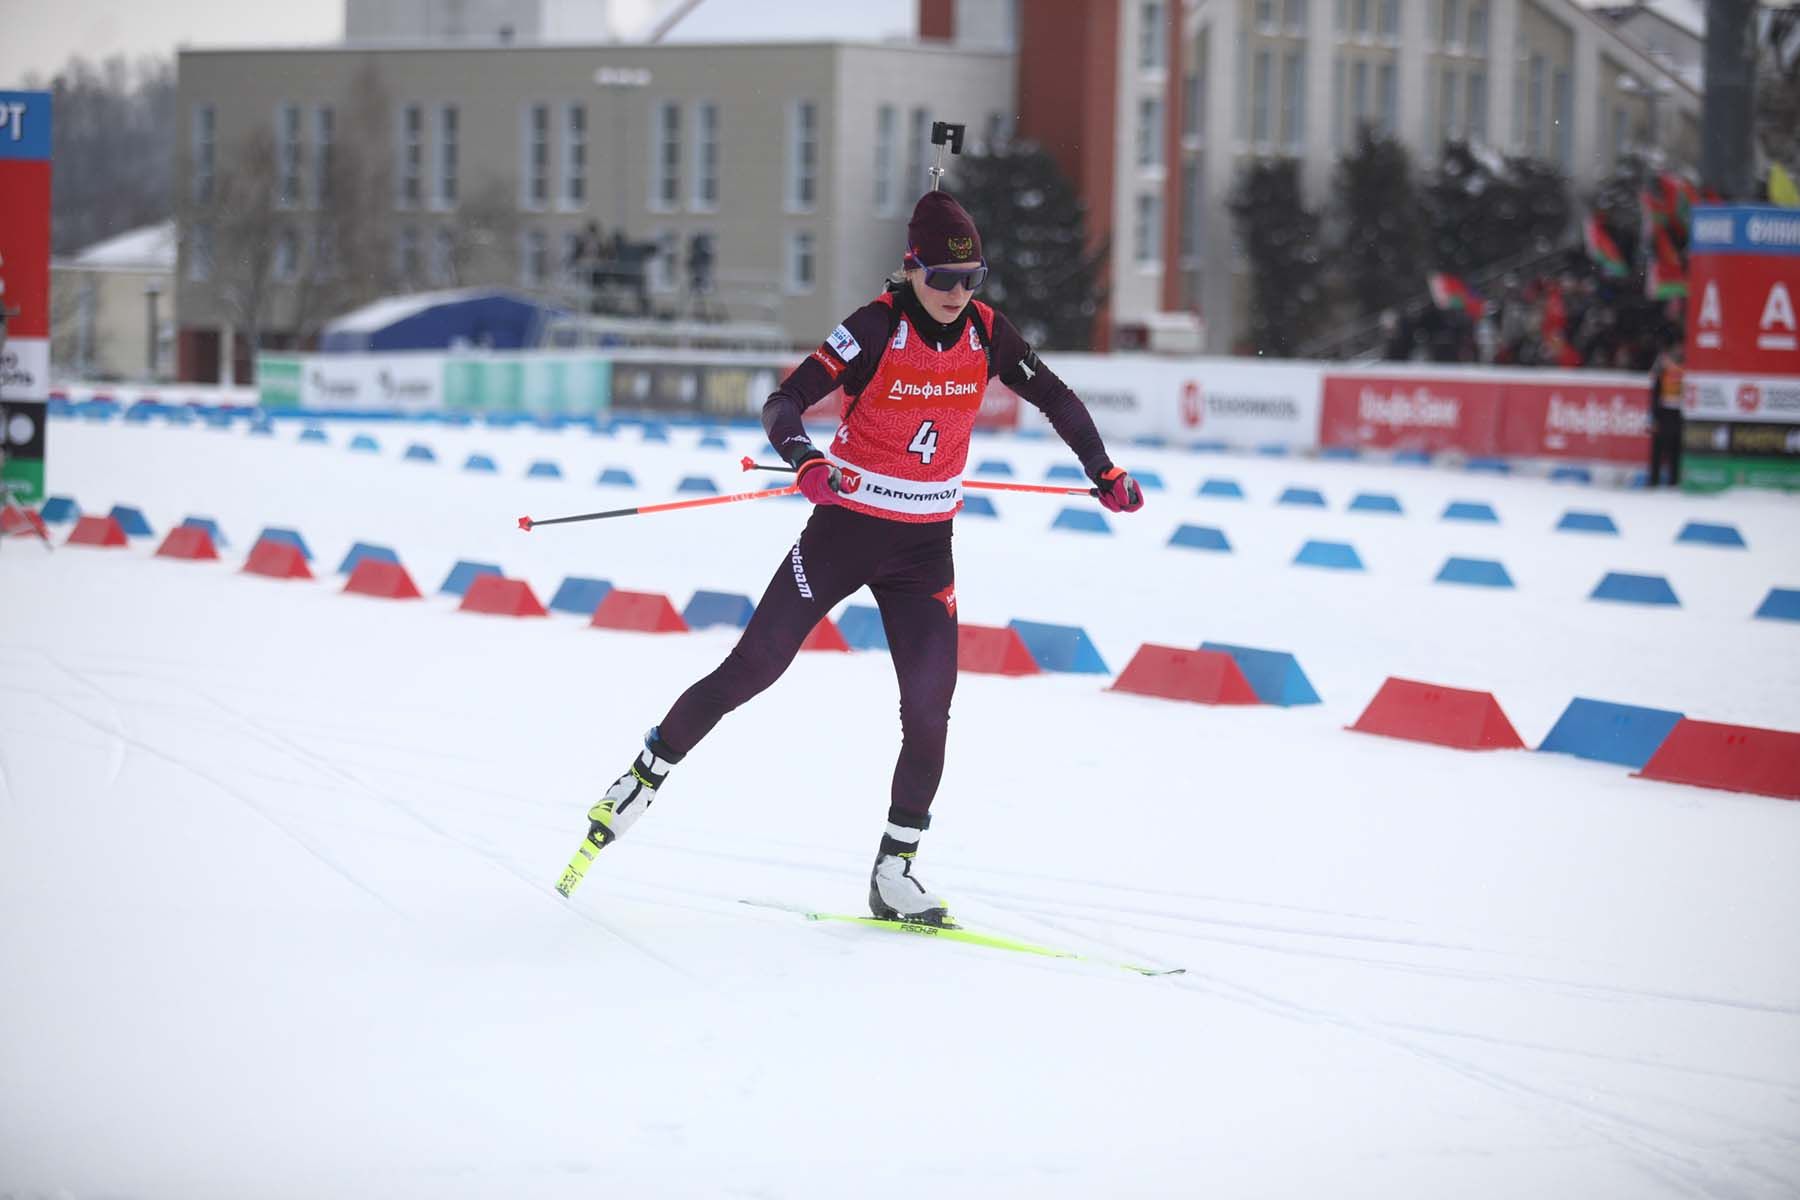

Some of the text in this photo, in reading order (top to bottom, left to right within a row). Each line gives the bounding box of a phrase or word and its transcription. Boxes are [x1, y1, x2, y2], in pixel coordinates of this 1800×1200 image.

[889, 379, 978, 400] Альфа Банк
[837, 424, 849, 444] 4
[906, 420, 939, 464] 4
